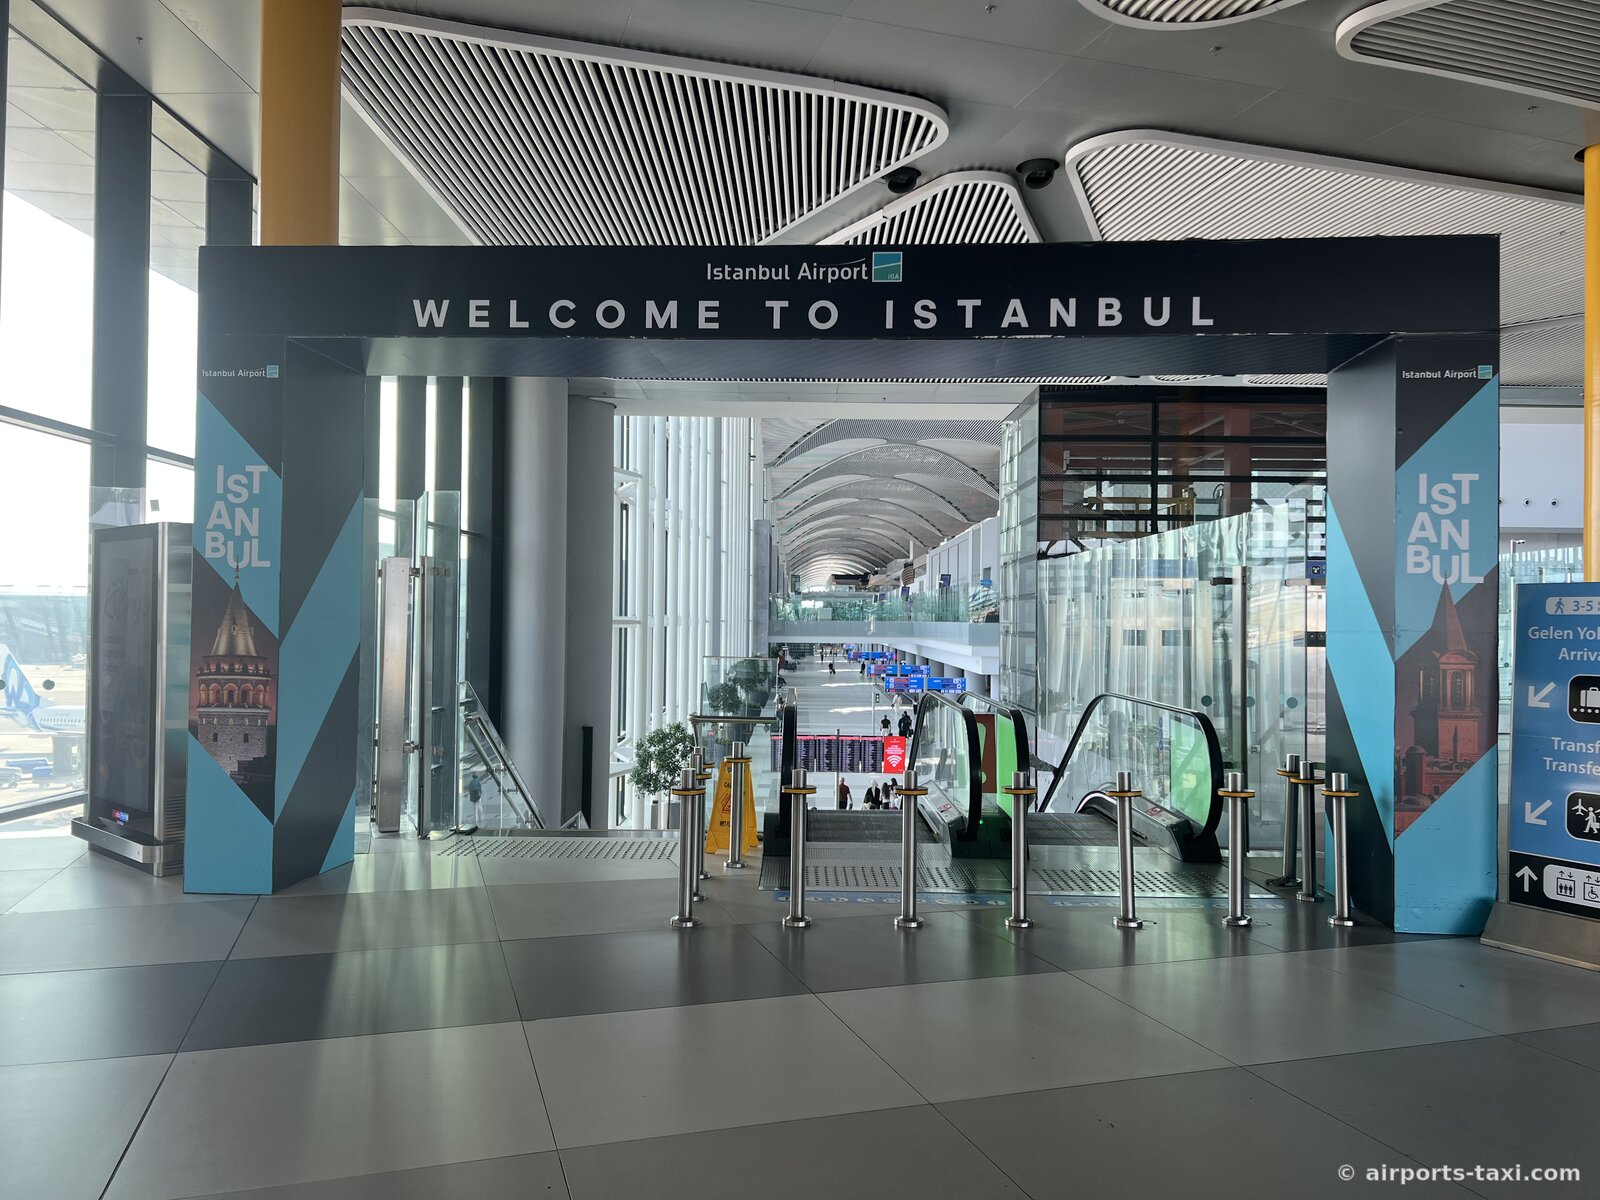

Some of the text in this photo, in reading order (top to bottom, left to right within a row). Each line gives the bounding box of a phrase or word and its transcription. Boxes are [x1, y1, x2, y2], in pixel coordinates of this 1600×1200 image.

[706, 261, 869, 284] Istanbul Airport
[412, 296, 1214, 330] WELCOME TO ISTANBUL
[202, 368, 266, 378] Istanbul Airport
[1402, 369, 1477, 380] Istanbul Airport
[205, 500, 260, 537] AN
[1407, 511, 1470, 551] AN
[205, 530, 271, 569] BUL
[1406, 544, 1485, 586] BUL
[1572, 600, 1594, 612] 3-5
[1528, 626, 1573, 640] Gelen
[1551, 736, 1600, 754] Transf
[1543, 756, 1600, 776] Transfe
